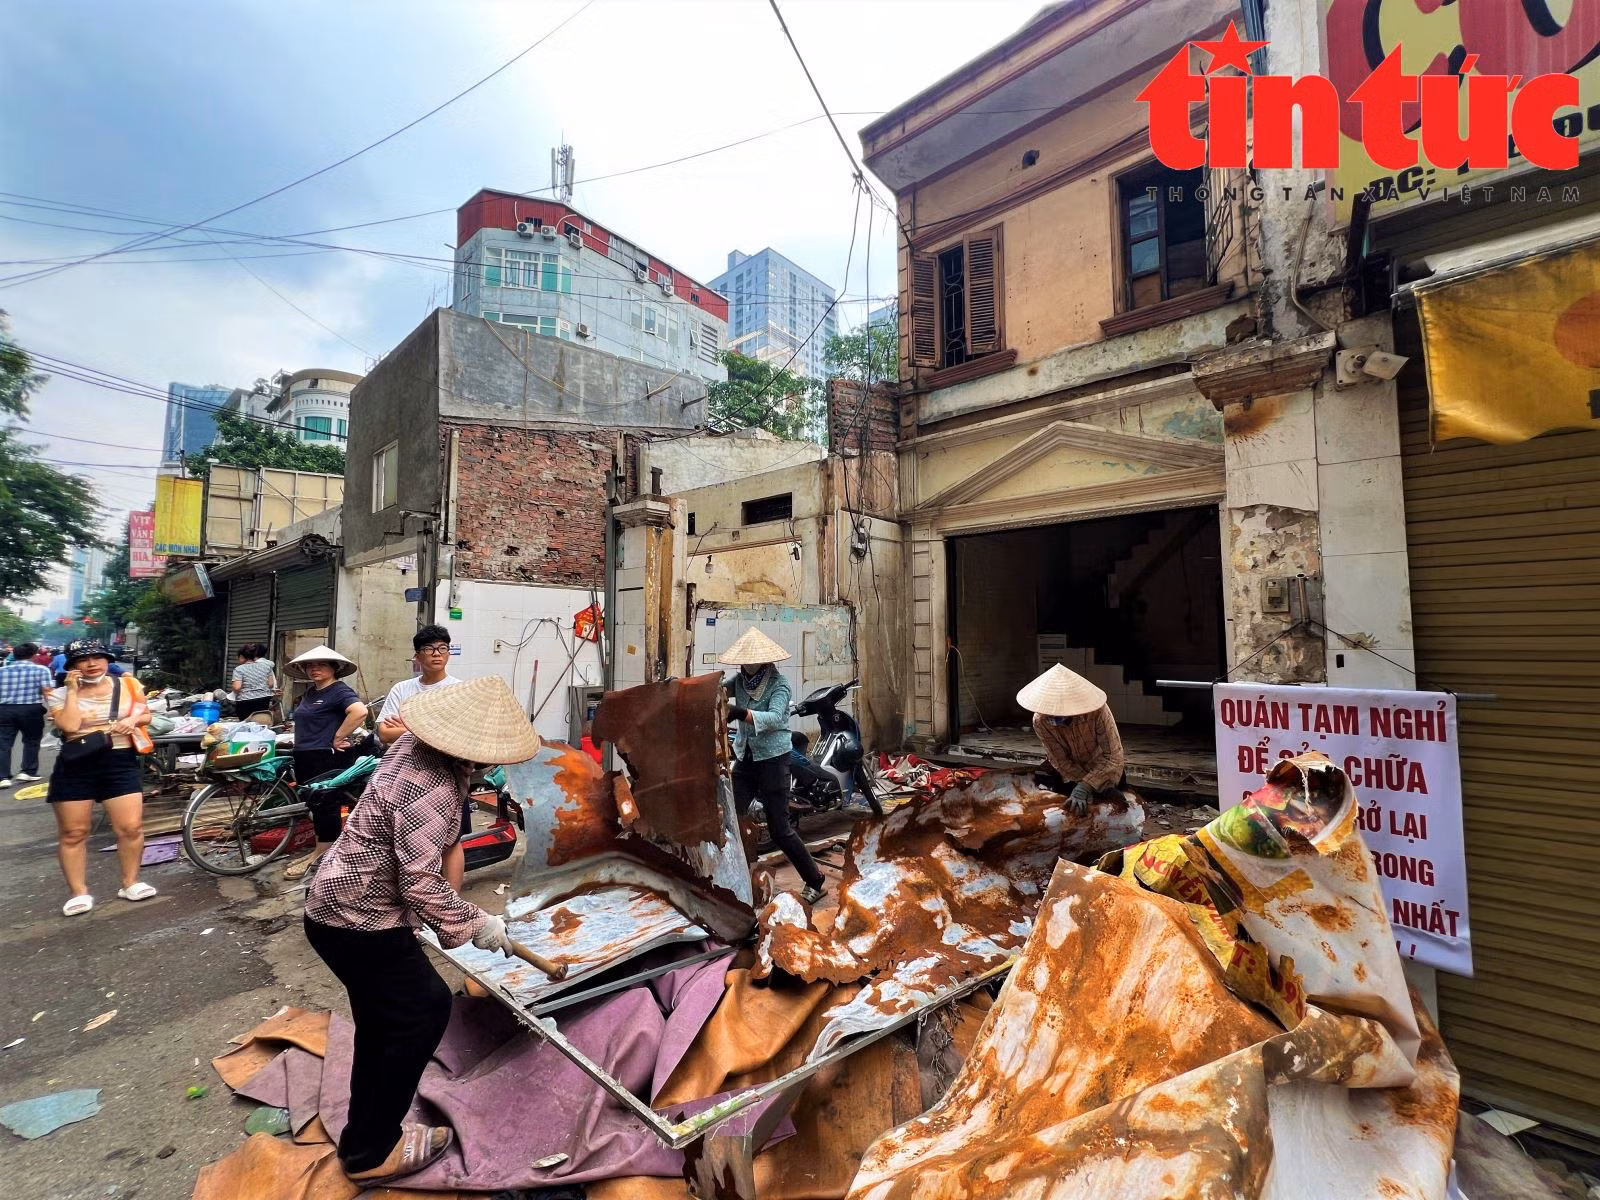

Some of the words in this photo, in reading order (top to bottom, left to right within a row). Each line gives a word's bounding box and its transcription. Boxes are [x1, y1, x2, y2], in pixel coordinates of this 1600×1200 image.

[1220, 695, 1290, 730] QUÁN
[1298, 703, 1359, 739] TẠM
[1369, 701, 1448, 743] NGHỈ
[1237, 736, 1271, 775] ĐỂ
[1343, 753, 1429, 795] CHỮA
[1389, 810, 1427, 844] LẠI
[1369, 850, 1435, 887] RONG
[1392, 898, 1460, 937] NHẤT
